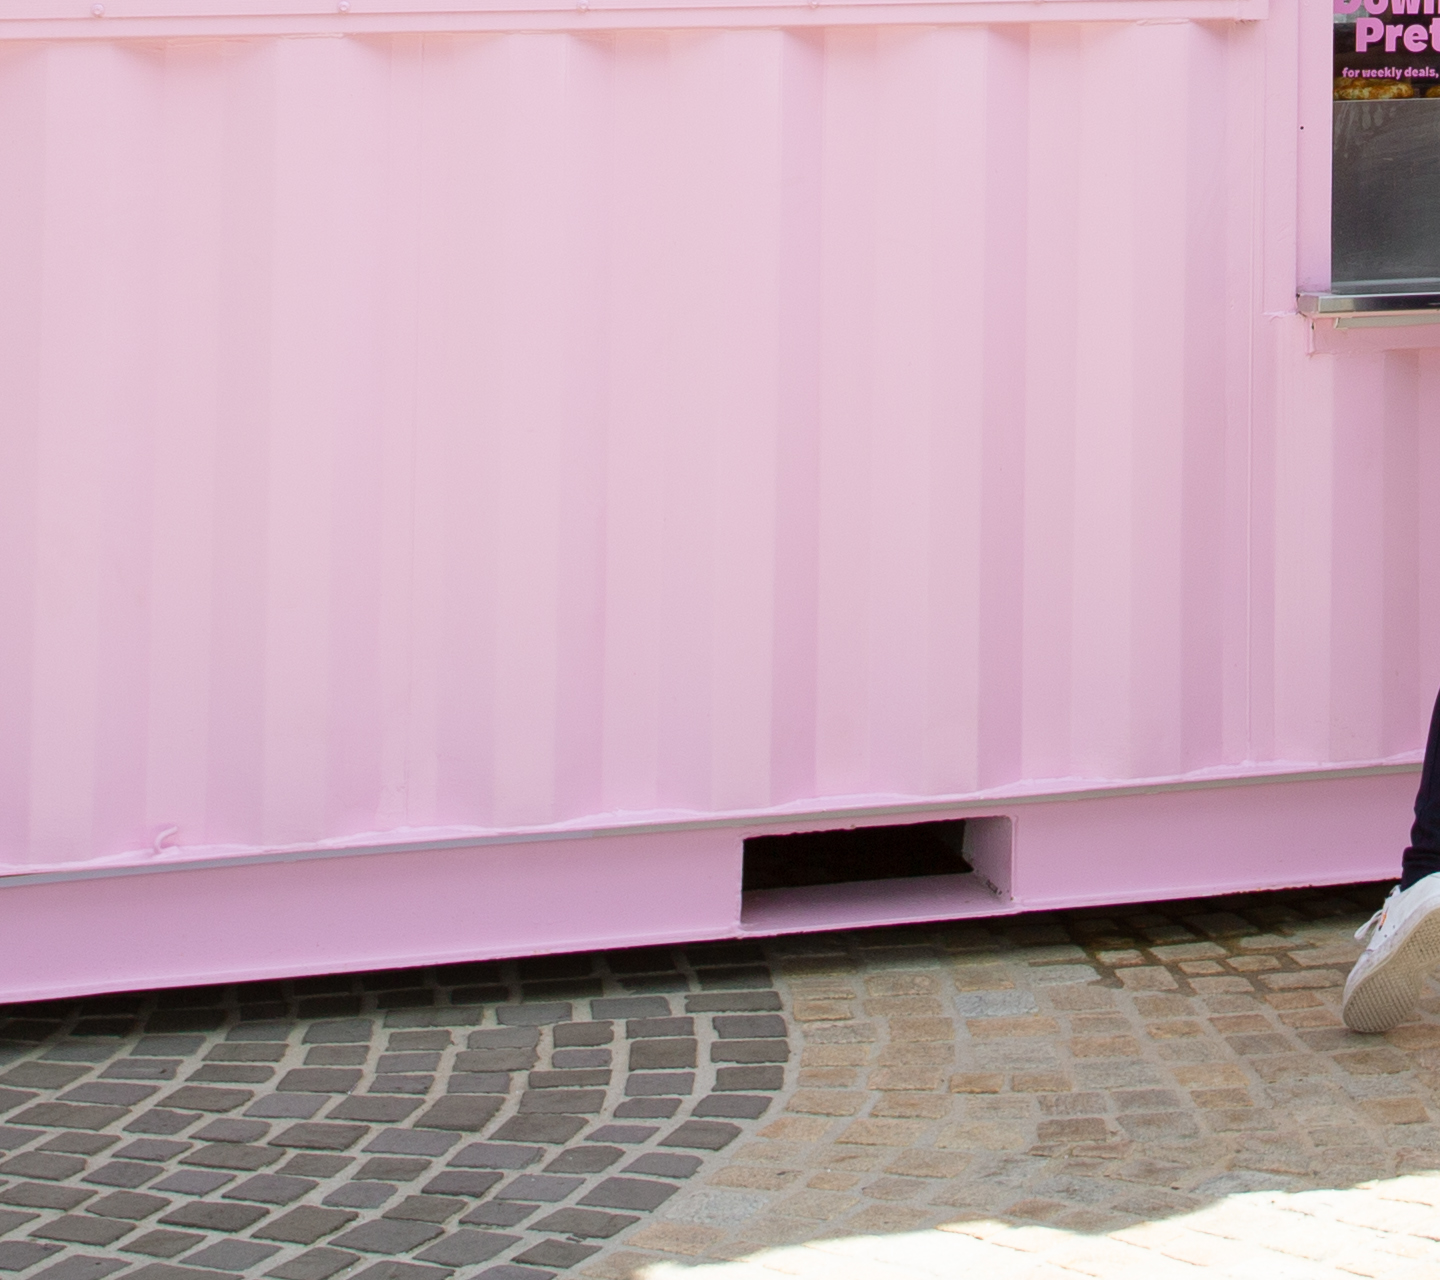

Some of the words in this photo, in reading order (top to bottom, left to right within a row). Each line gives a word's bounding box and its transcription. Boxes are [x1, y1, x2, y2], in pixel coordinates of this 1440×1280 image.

[1342, 67, 1359, 78] for
[1361, 66, 1402, 79] weekly
[1404, 66, 1439, 78] deals,
